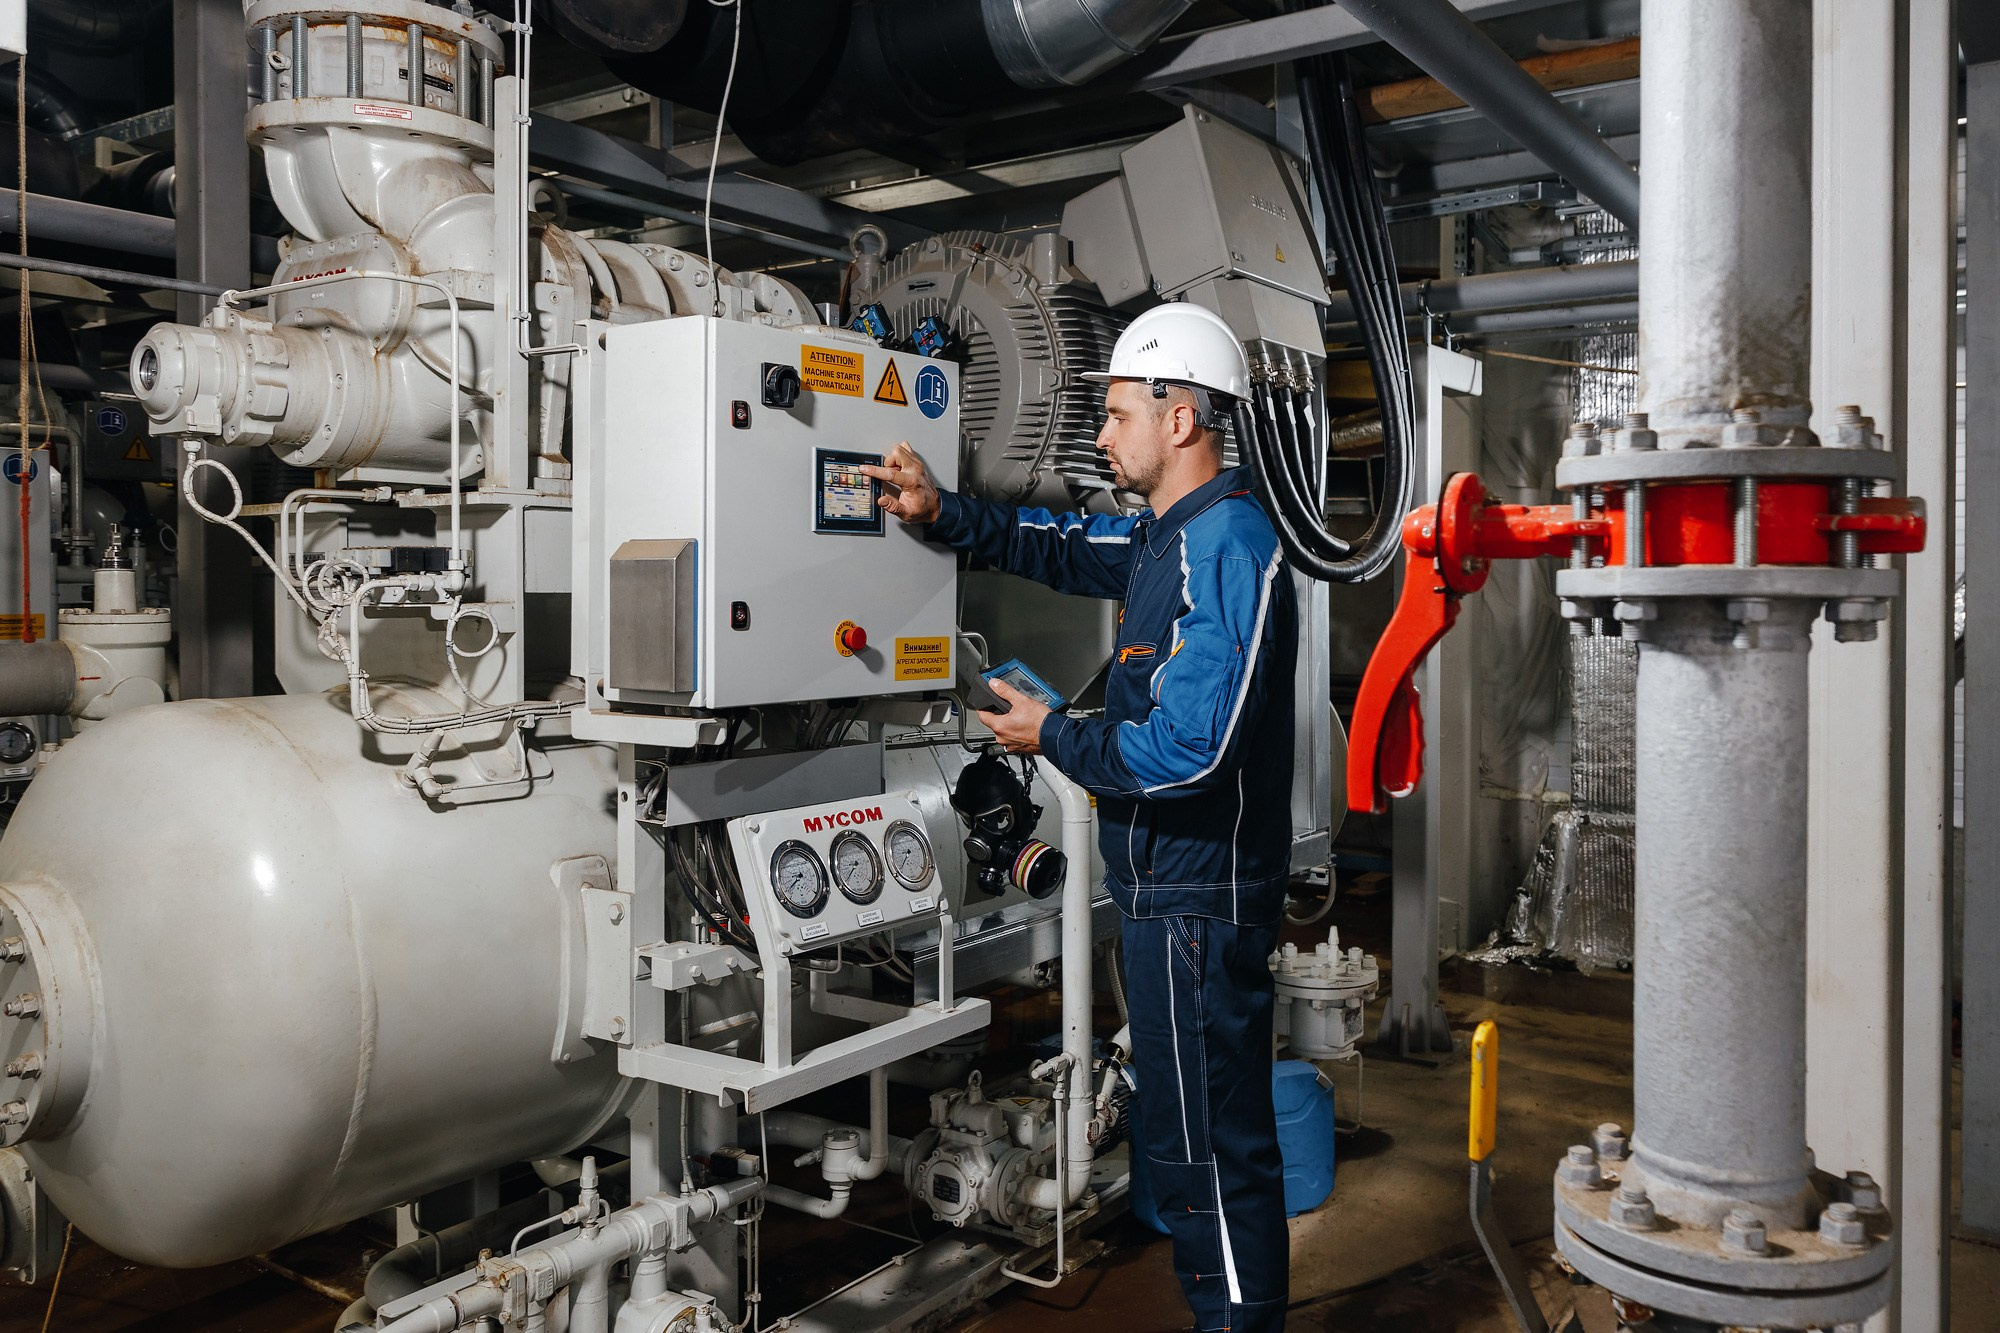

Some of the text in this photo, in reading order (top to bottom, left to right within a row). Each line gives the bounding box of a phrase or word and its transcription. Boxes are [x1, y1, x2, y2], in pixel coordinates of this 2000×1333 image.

[809, 351, 856, 366] ATTENTION:
[804, 367, 861, 382] MACHINE STARTS
[805, 378, 860, 392] AUTOMATICALLY
[904, 642, 942, 652] Внимание!
[916, 656, 949, 664] ЗАПУСКАЕТСЯ
[903, 667, 943, 675] АВТОМАТИЧЕСКИ
[803, 806, 884, 833] MYCOM
